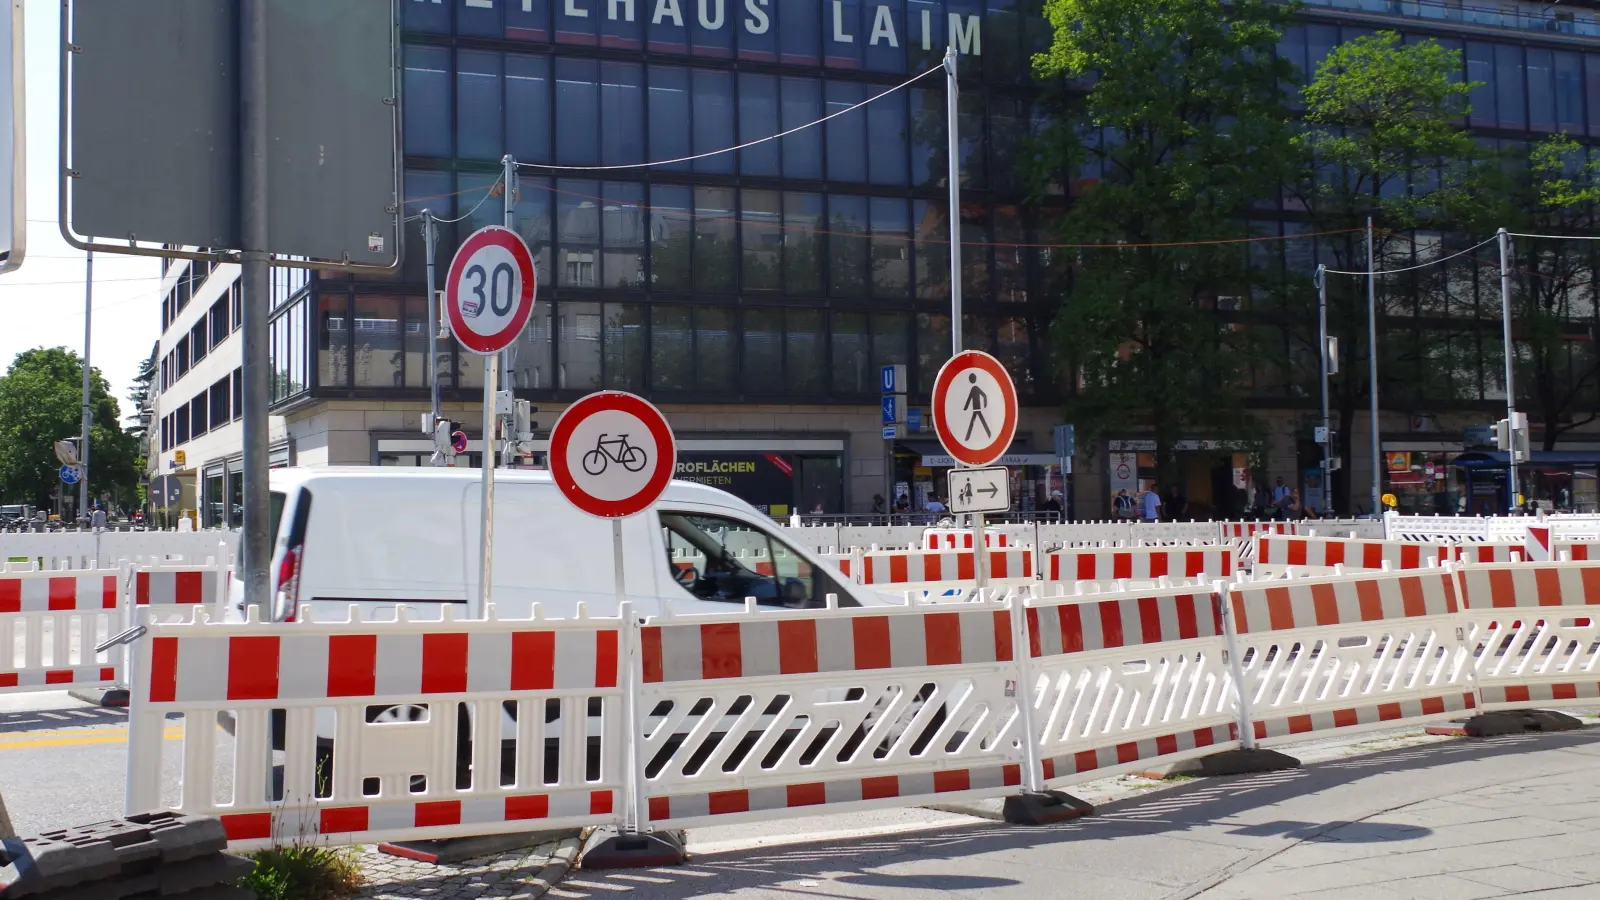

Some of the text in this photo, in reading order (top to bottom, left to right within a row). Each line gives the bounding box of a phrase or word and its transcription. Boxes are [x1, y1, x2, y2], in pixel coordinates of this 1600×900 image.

[412, 0, 981, 56] HAUS LAIM
[465, 262, 514, 317] 30
[884, 369, 893, 389] U
[676, 460, 756, 473] ROFLÄCHEN
